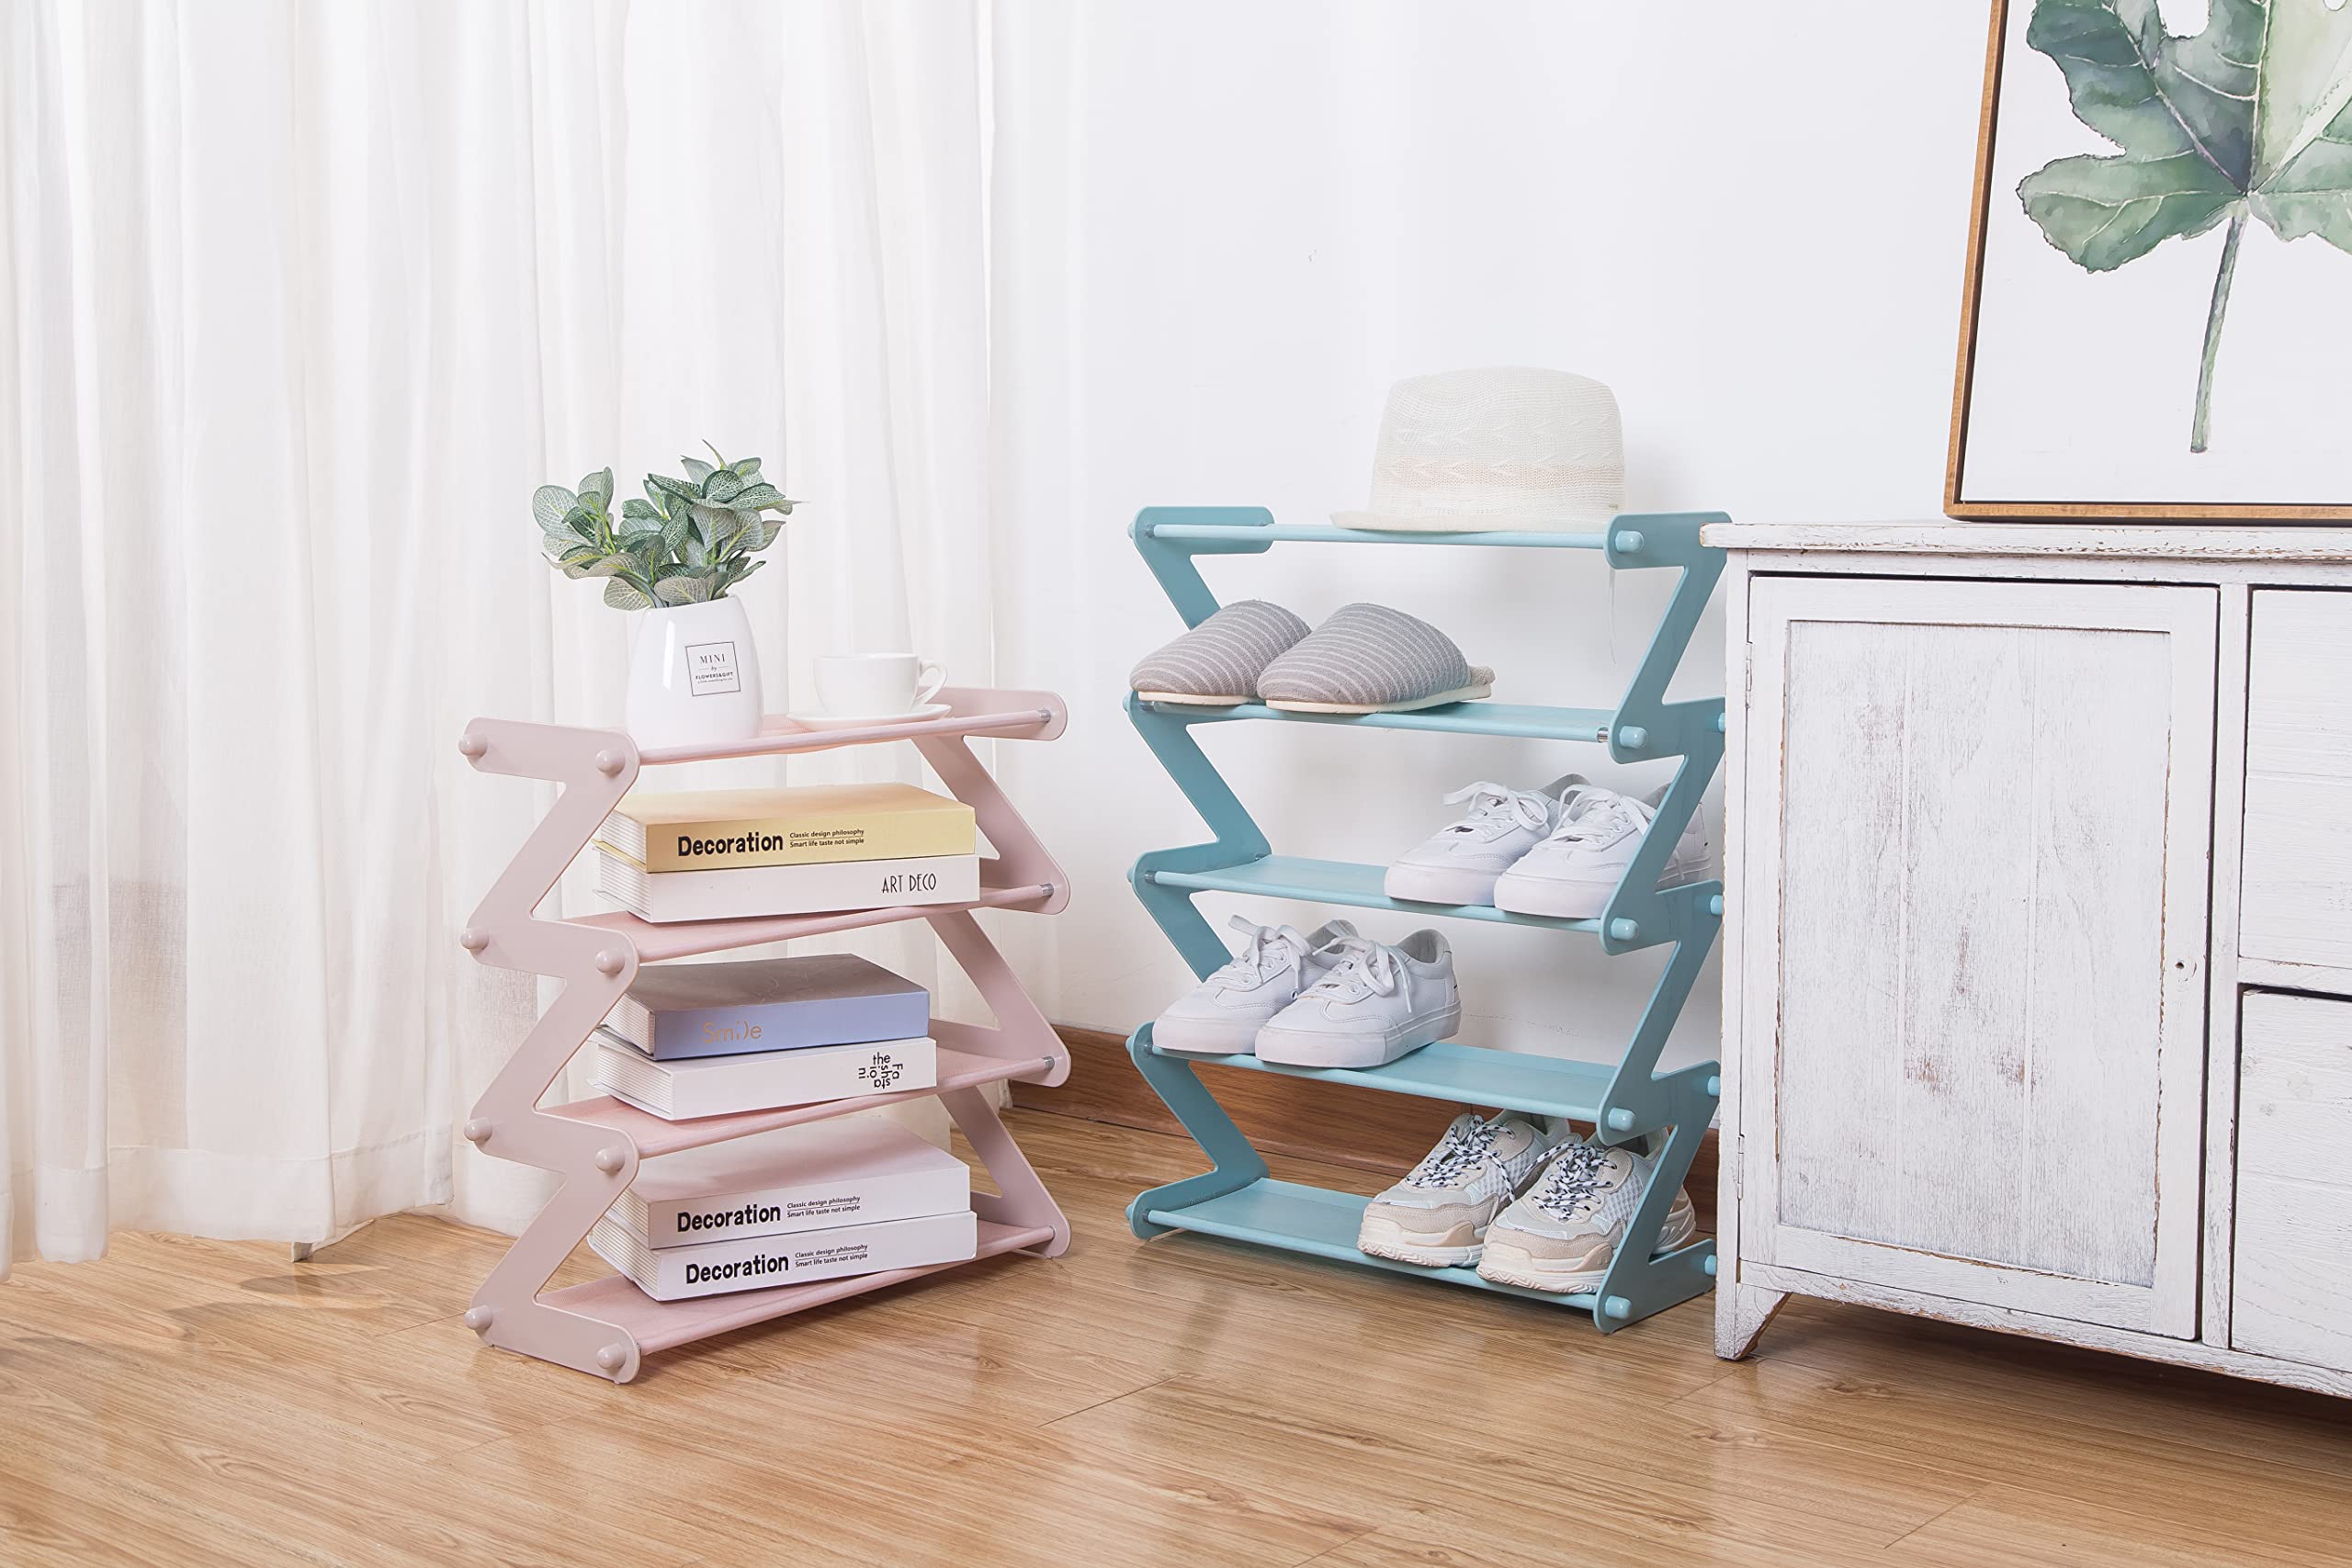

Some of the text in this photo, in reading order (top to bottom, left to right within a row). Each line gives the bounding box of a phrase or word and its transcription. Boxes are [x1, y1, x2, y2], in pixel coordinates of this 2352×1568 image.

[700, 653, 725, 663] MINI
[677, 831, 784, 857] Decoration
[845, 837, 865, 845] simple
[881, 873, 937, 894] ART DECO
[873, 1051, 891, 1066] the
[828, 1195, 861, 1205] philosophy
[842, 1203, 861, 1213] simple
[677, 1203, 781, 1232] Decoration
[836, 1244, 868, 1253] philosophy
[795, 1259, 812, 1268] Smart
[824, 1257, 838, 1265] taste
[849, 1252, 868, 1261] simple
[685, 1254, 789, 1284] Decoration
